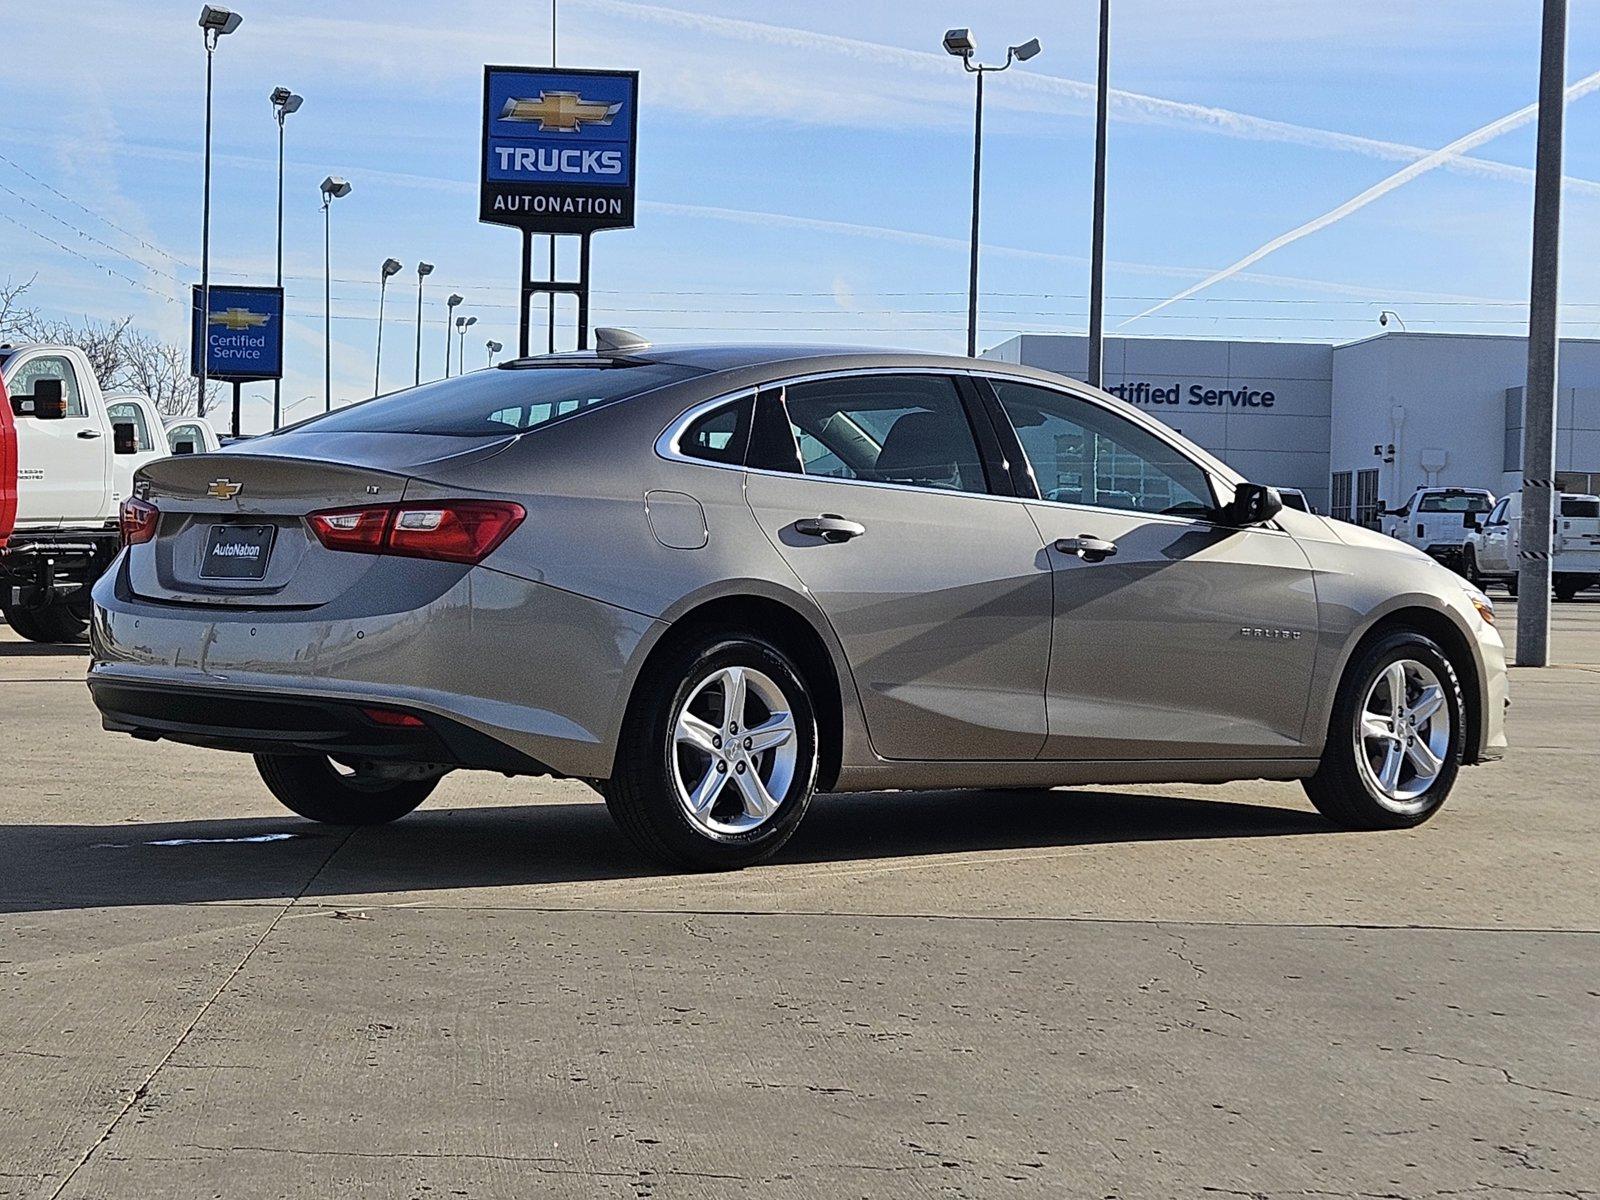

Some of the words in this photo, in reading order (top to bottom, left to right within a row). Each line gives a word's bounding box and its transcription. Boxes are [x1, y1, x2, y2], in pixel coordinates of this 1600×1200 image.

[495, 147, 622, 174] TRUCKS
[493, 195, 622, 214] AUTONATION
[209, 335, 265, 347] Certified
[214, 347, 260, 359] Service
[1101, 382, 1180, 405] rtified
[1188, 384, 1275, 407] Service
[212, 543, 260, 556] AutoNation
